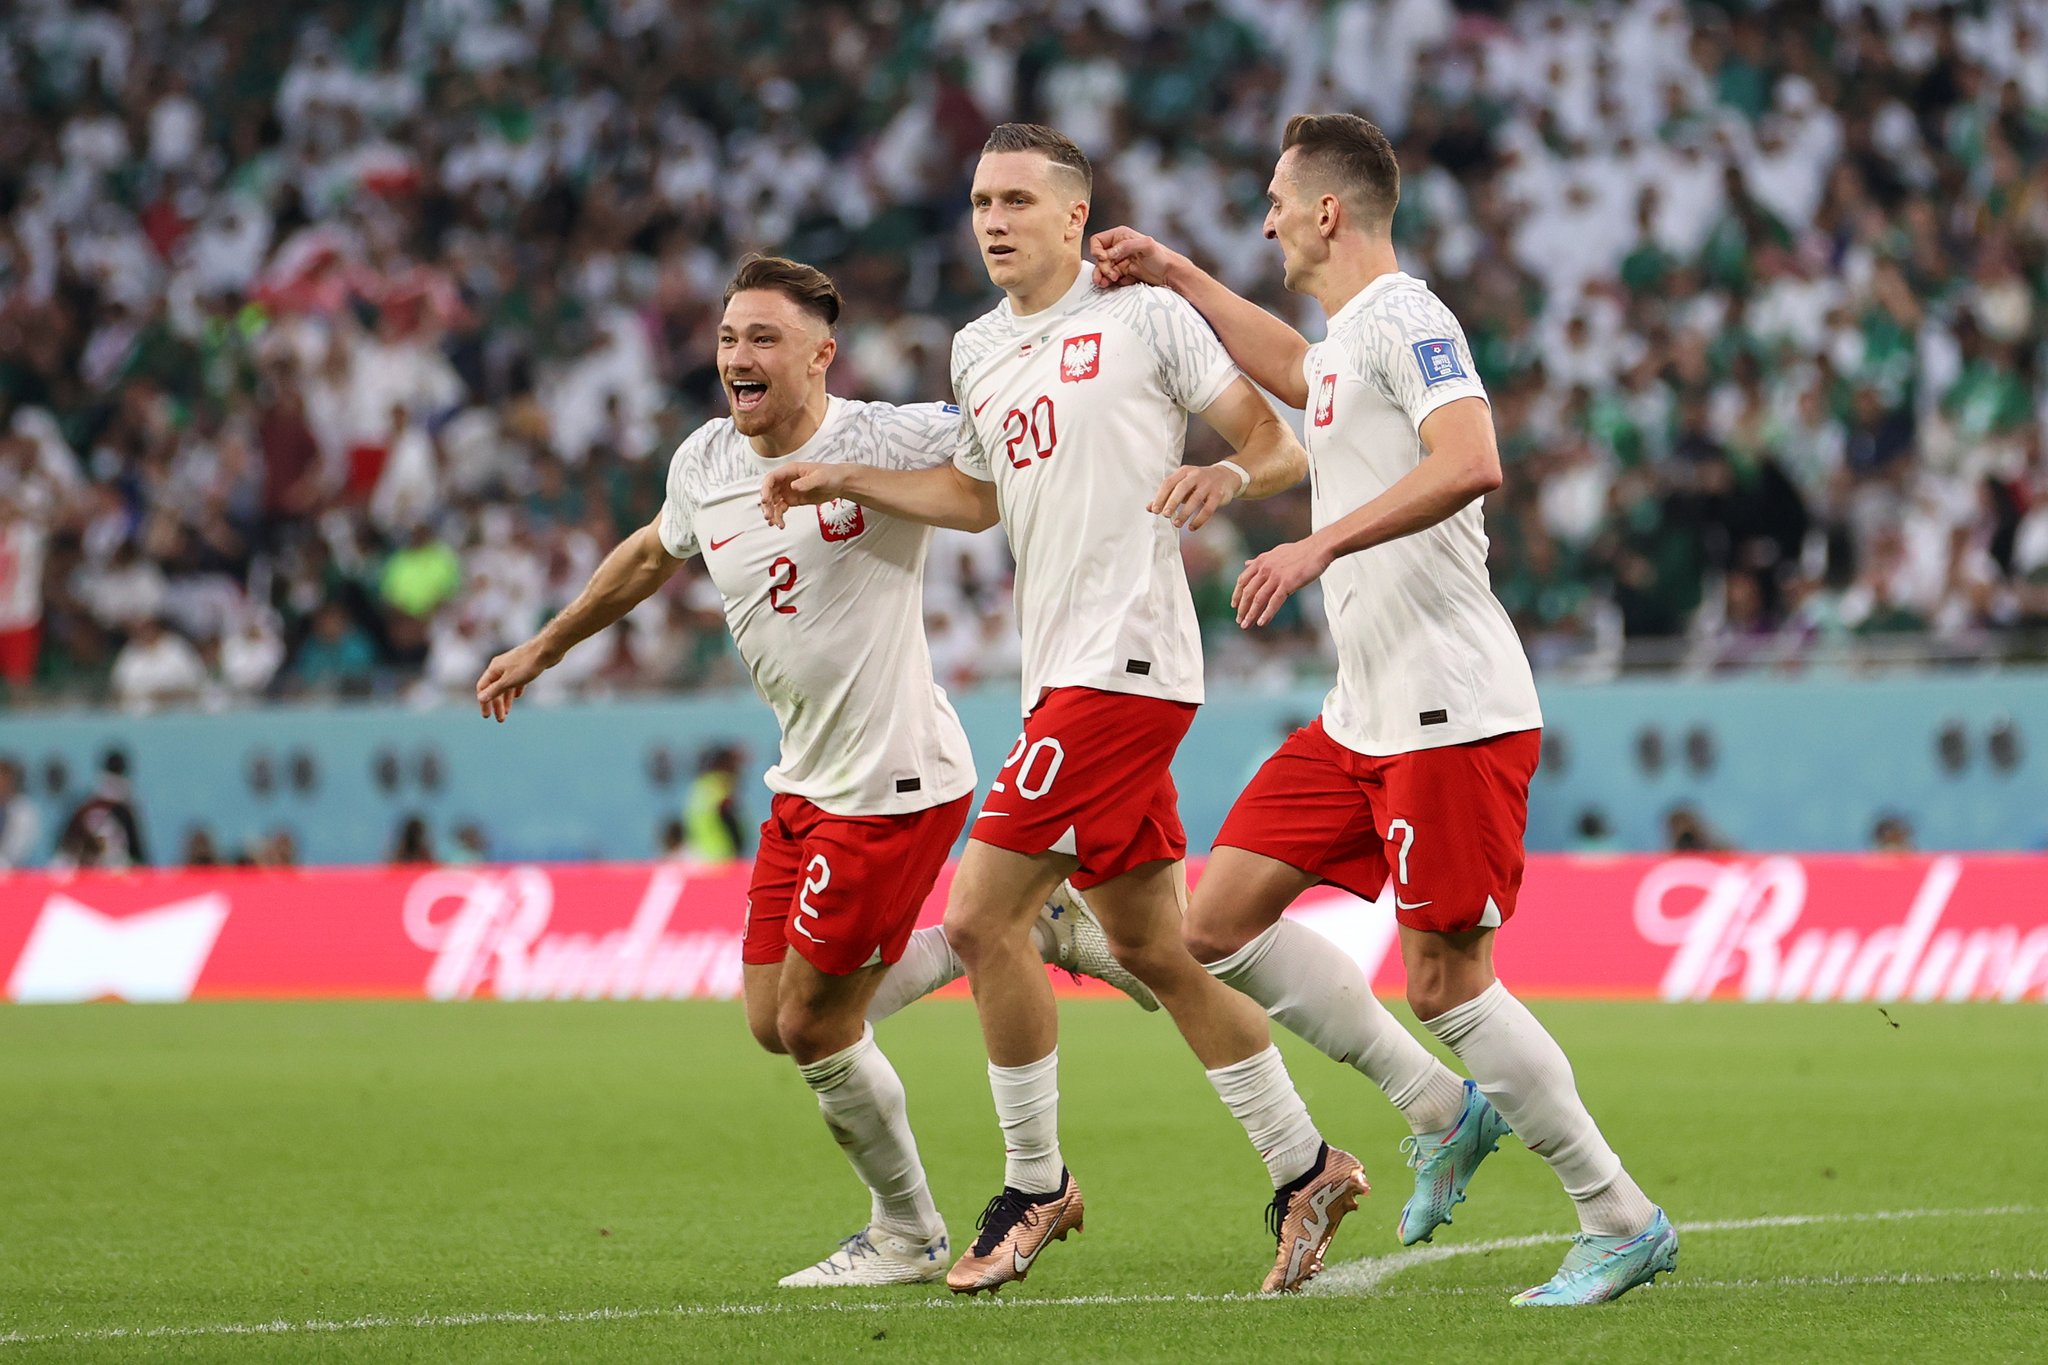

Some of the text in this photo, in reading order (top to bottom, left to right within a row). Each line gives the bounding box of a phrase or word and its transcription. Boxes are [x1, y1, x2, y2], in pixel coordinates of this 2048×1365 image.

[1003, 395, 1057, 469] 20
[769, 556, 797, 614] 2
[1387, 819, 1414, 884] 7
[800, 854, 830, 918] 2
